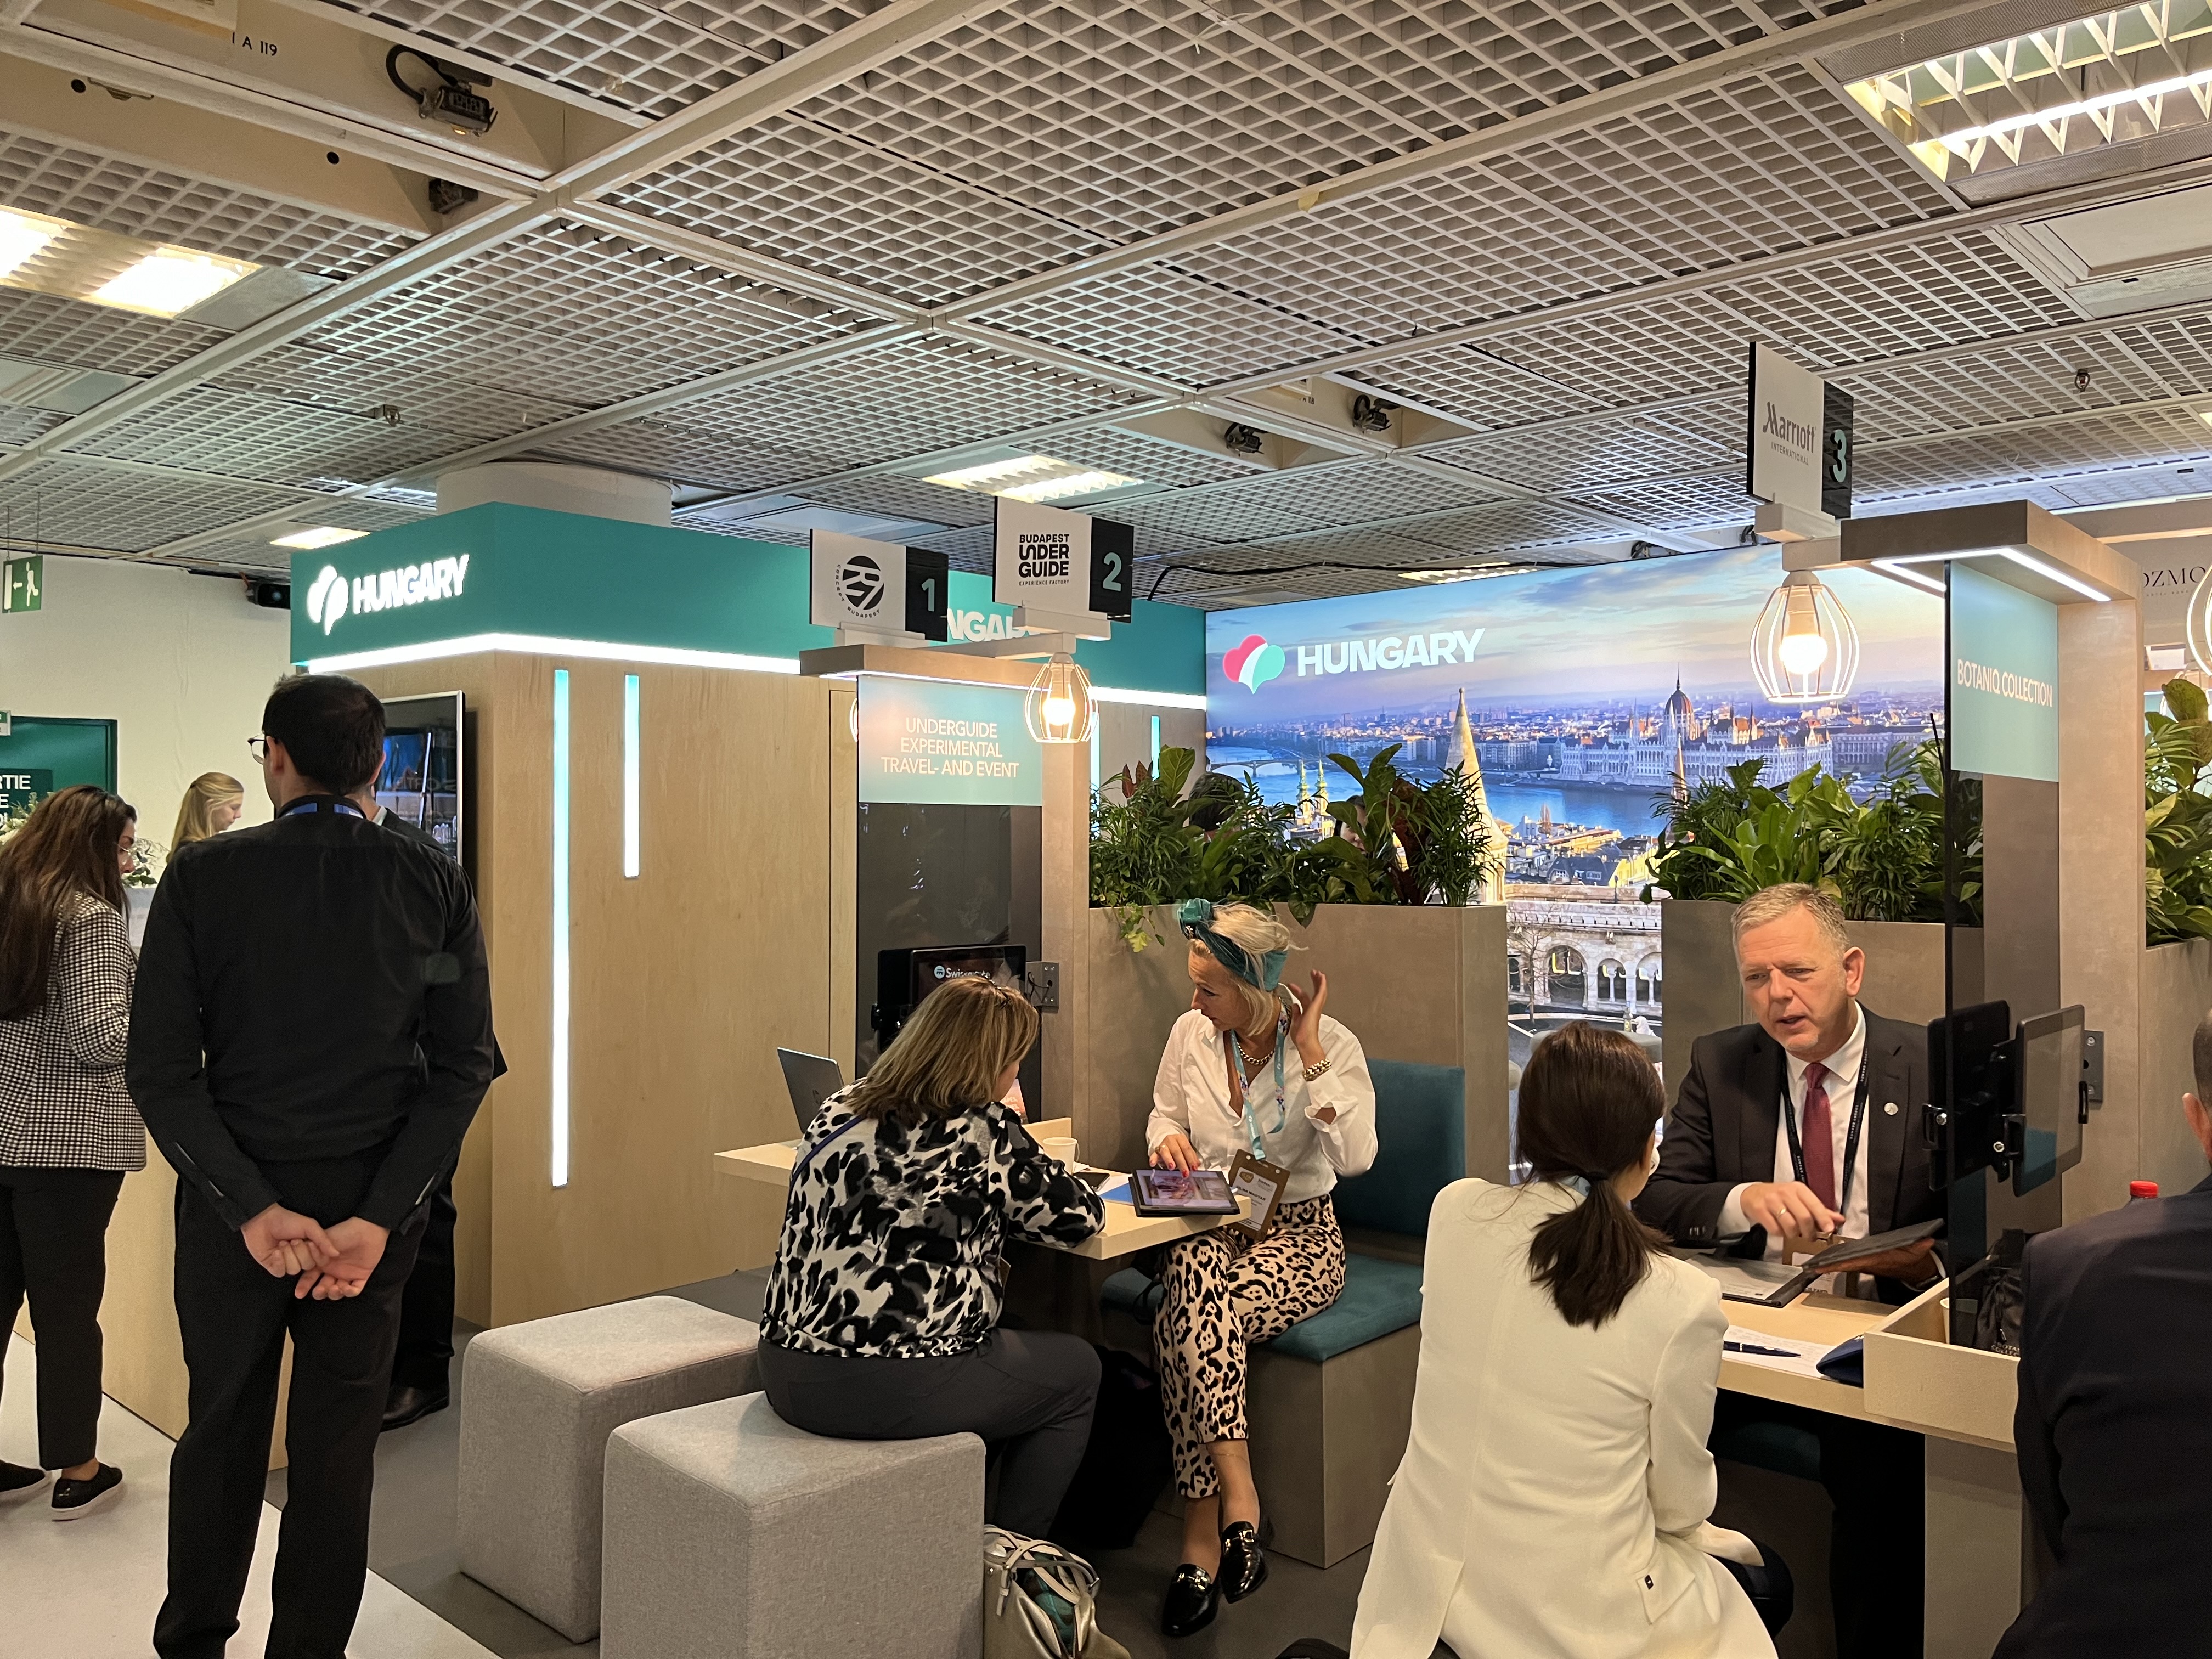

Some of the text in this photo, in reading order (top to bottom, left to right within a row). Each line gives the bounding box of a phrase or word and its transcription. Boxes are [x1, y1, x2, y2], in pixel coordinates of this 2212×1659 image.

[242, 36, 252, 50] A
[261, 40, 277, 56] 119
[1762, 401, 1815, 454] Marriott
[1771, 441, 1809, 466] INTERNATIONAL
[1832, 429, 1847, 483] 3
[1019, 534, 1070, 543] BUDAPEST
[1019, 544, 1069, 560] UNDER
[1018, 561, 1069, 578] GUIDE
[1103, 552, 1122, 592] 2
[353, 553, 470, 614] HUNGARY
[921, 578, 935, 612] 1
[847, 606, 881, 618] BUDAPEST
[1297, 628, 1486, 677] HUNGARY
[1957, 659, 2052, 708] BOTANIQ COLLECTION
[906, 717, 997, 738] UNDERGUIDE
[900, 737, 1003, 758] EXPERIMENTAL
[881, 757, 1019, 777] TRAVEL- AND EVENT
[0, 775, 31, 789] TIE
